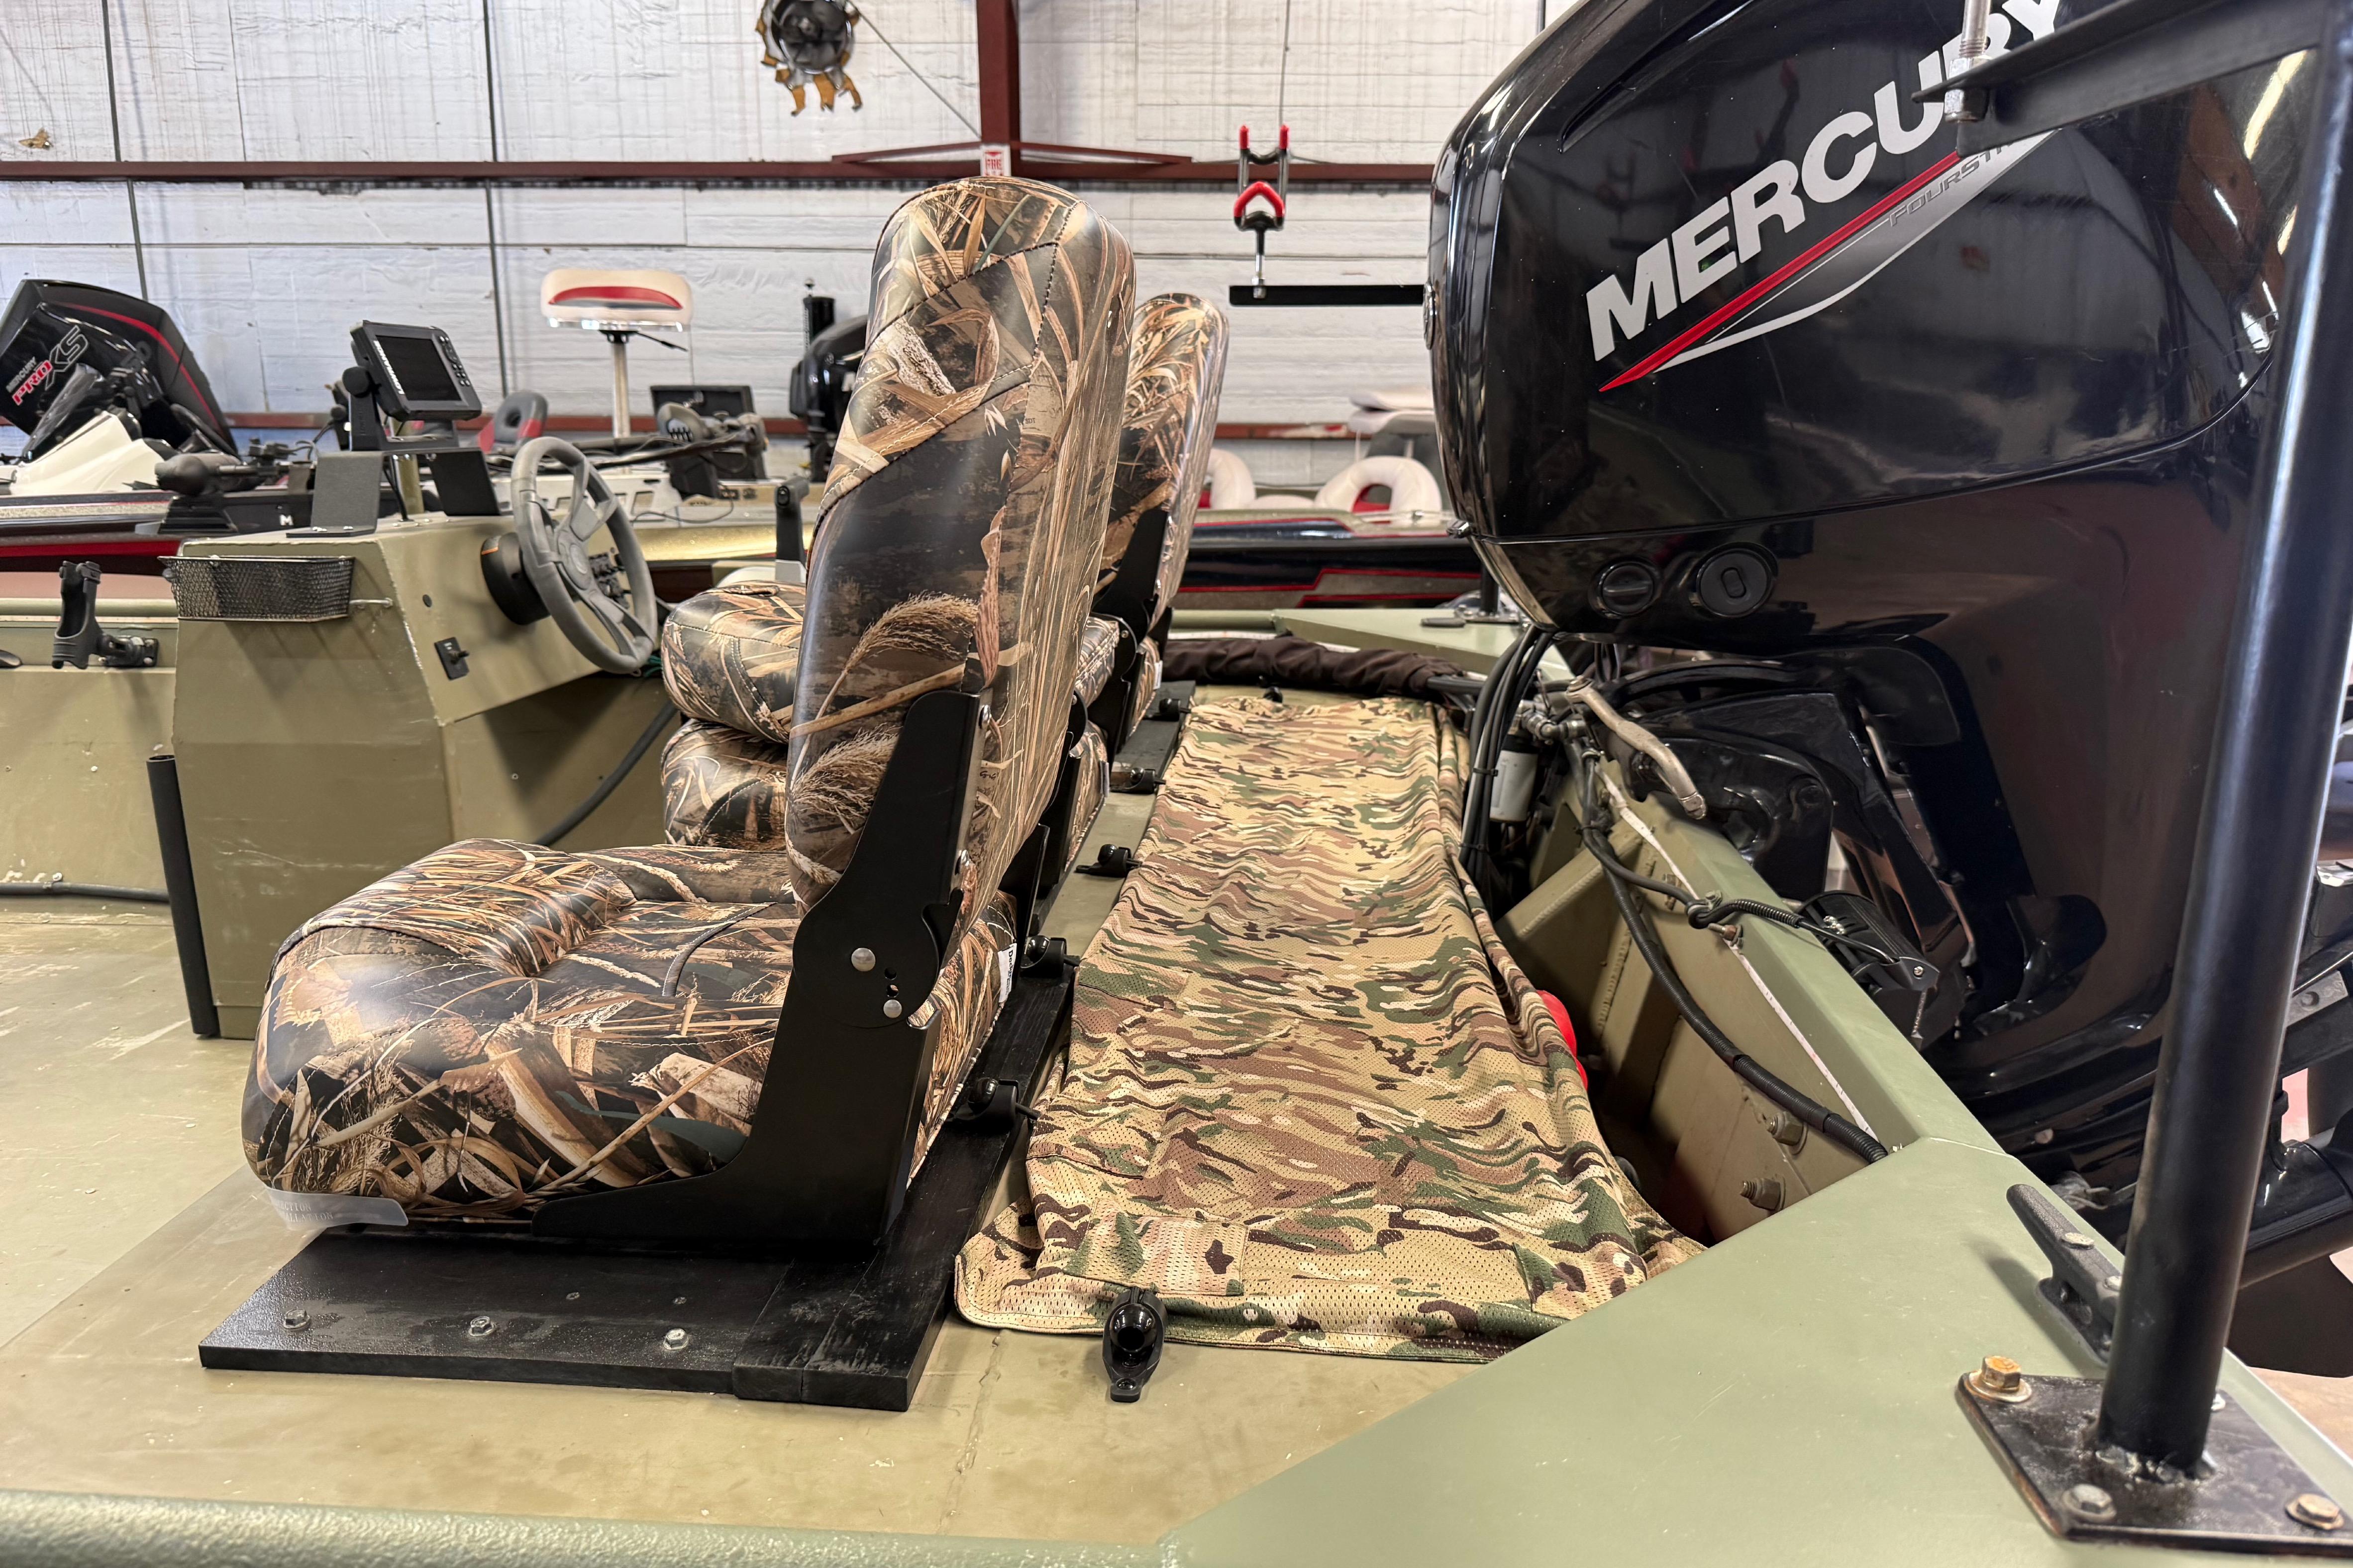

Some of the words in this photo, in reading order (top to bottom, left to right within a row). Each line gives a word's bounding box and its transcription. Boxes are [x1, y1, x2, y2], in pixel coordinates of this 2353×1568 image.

[12, 359, 53, 406] PRO
[45, 325, 89, 391] XS
[373, 340, 405, 394] LOWRANCE
